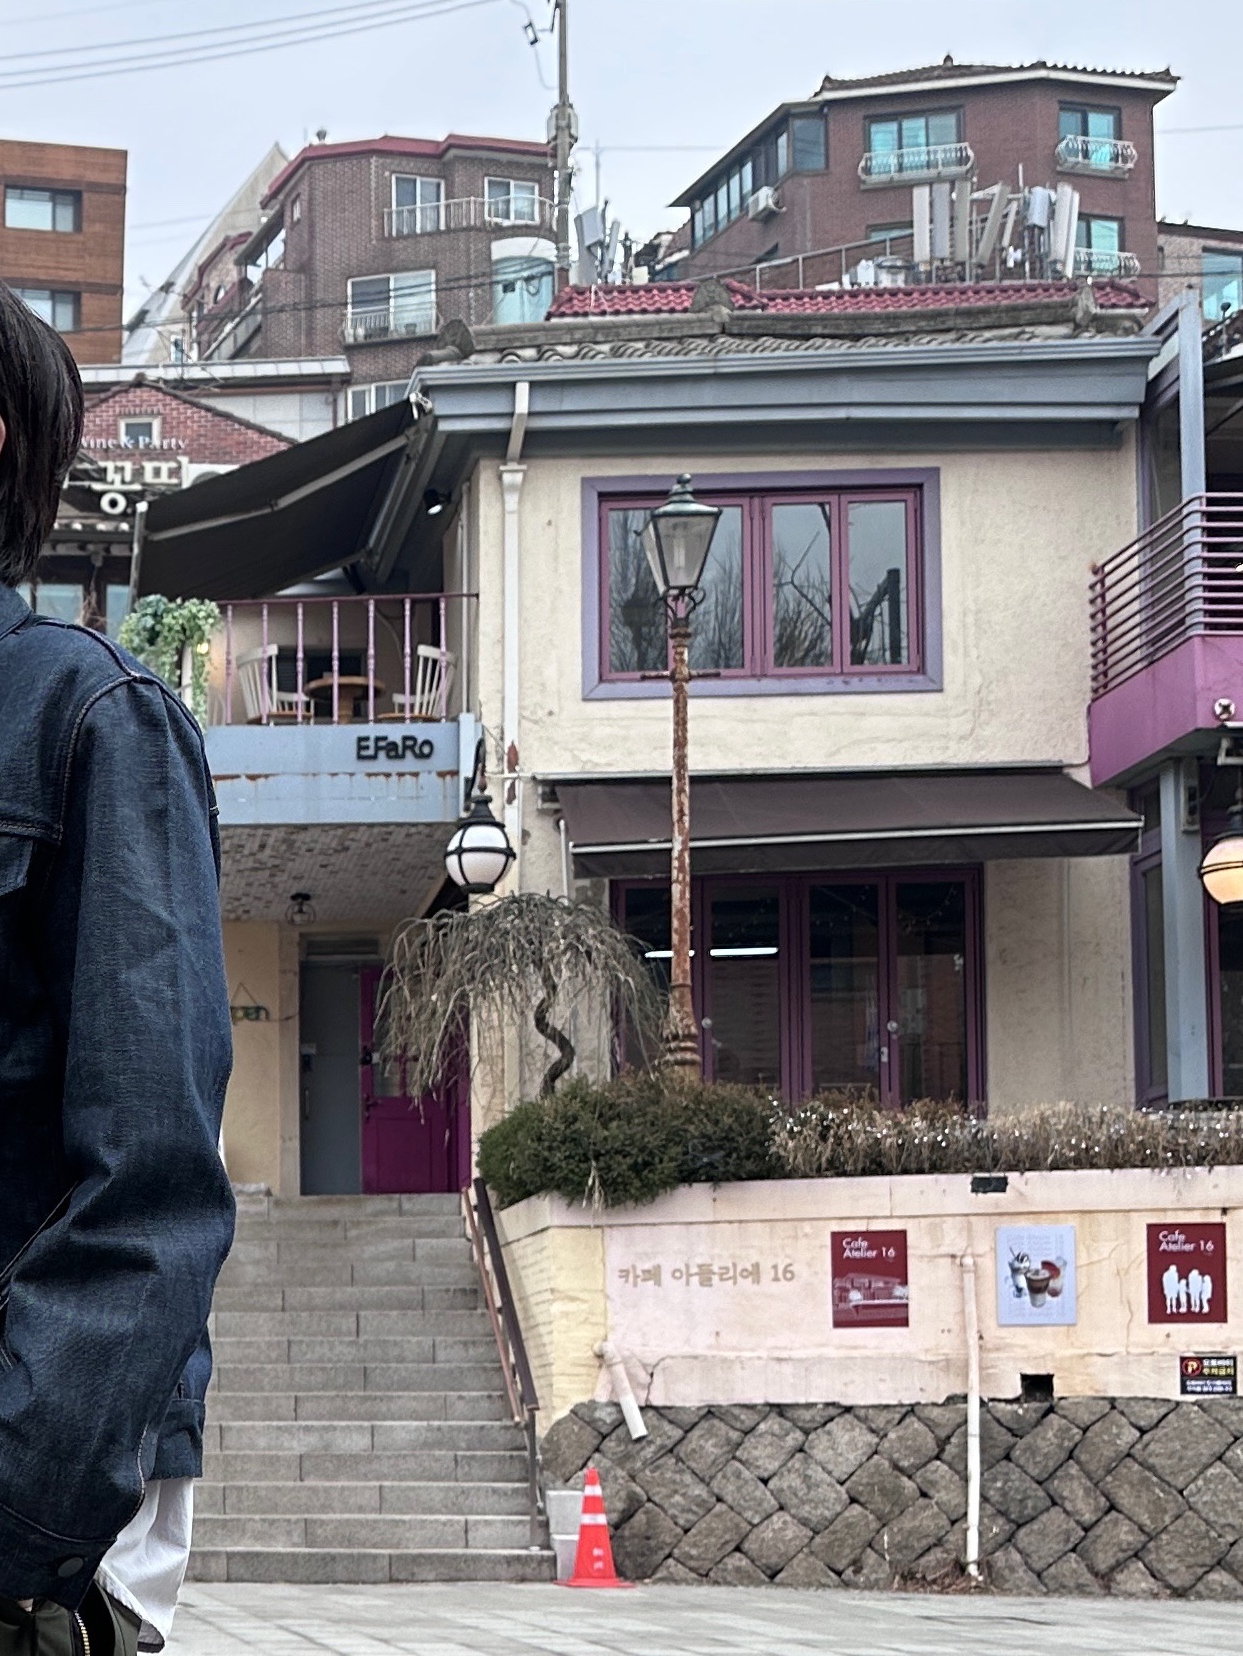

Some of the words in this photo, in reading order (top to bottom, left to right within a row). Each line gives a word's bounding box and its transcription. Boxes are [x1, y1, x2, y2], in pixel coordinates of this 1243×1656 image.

[138, 435, 189, 450] Party
[356, 734, 434, 760] EFaRo
[230, 1005, 270, 1026] pen
[881, 1246, 896, 1258] 16
[1199, 1239, 1215, 1252] 16
[617, 1263, 662, 1288] 카페
[770, 1262, 796, 1283] 16
